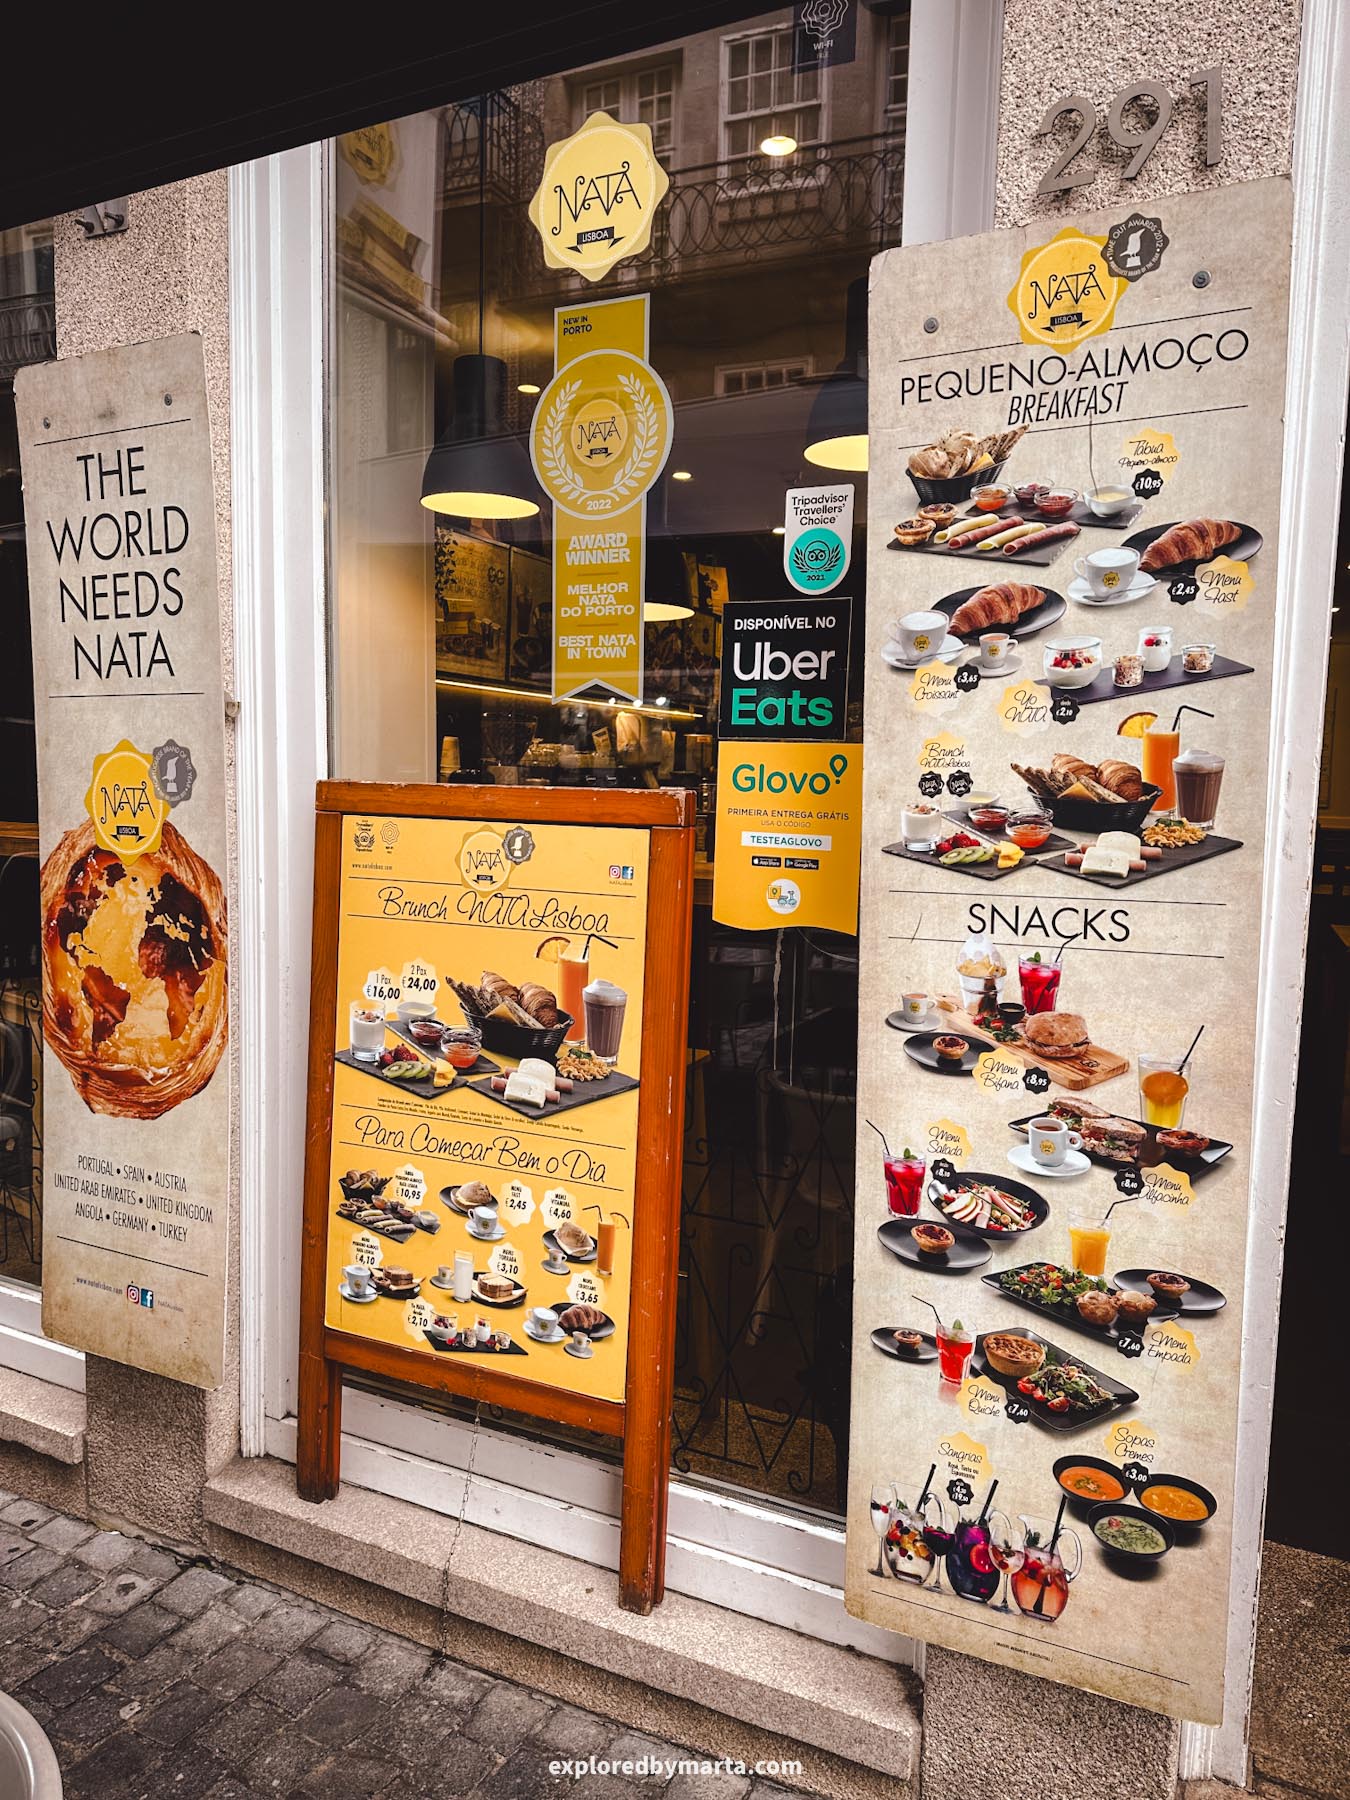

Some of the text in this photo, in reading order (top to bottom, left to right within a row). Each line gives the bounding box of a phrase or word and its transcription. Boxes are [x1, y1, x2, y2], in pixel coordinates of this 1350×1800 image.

[813, 40, 833, 50] WI-FI
[1037, 66, 1223, 195] 291
[552, 161, 642, 236] NATA
[582, 231, 608, 243] LISBOA
[1113, 224, 1127, 239] OUT
[1128, 218, 1157, 232] AWARDS
[1154, 229, 1164, 248] 2012
[1028, 264, 1106, 319] NATA
[563, 317, 579, 326] NEW
[1054, 315, 1078, 324] LISBOA
[563, 324, 592, 336] PORTO
[901, 329, 1249, 405] PEQUENO-ALMOÇO
[1007, 381, 1129, 426] BREAKFAST
[577, 416, 621, 449] NATA
[77, 446, 146, 501] THE
[1135, 476, 1161, 490] €10,95
[587, 500, 611, 511] 2022
[792, 493, 848, 507] Tripadvisor
[800, 515, 836, 526] Choice
[47, 505, 189, 565] WORLD
[568, 533, 627, 550] AWARD
[565, 548, 630, 565] WINNER
[1200, 570, 1242, 587] Menu
[59, 567, 184, 622] NEEDS
[568, 583, 628, 595] MELHOR
[1171, 583, 1195, 596] €2,45
[579, 594, 616, 605] NATA
[560, 605, 635, 617] DO PORTO
[734, 614, 836, 631] DISPONÍVEL NO
[559, 634, 636, 648] BEST NATA
[73, 629, 174, 680] NATA
[567, 647, 627, 659] IN TOWN
[733, 641, 835, 681] Uber
[920, 672, 952, 687] Menu
[957, 672, 978, 683] €3,65
[914, 687, 960, 701] Croissant
[731, 687, 833, 727] Eats
[1005, 706, 1048, 723] NATA
[164, 745, 179, 754] BRAND
[925, 743, 965, 757] Brunch
[732, 763, 831, 795] Glovo
[100, 781, 155, 824] NATA
[727, 808, 849, 821] PRIMEIRA ENTREGA GRÁTIS
[783, 820, 811, 828] CÓDIGO
[750, 835, 822, 847] TESTEAGLOVO
[466, 849, 505, 873] NATA
[378, 886, 447, 920] Brunch
[967, 903, 1130, 942] SNACKS
[411, 965, 427, 976] 2 Pax
[376, 974, 391, 985] 1 Pax
[983, 1058, 1018, 1075] Menu
[980, 1072, 1019, 1091] Bifana
[1026, 1074, 1047, 1086] €8,95
[929, 1127, 960, 1142] Menu
[355, 1115, 404, 1148] Para
[410, 1122, 493, 1163] Começar
[493, 1136, 540, 1172] Bem
[546, 1157, 559, 1174] o
[562, 1149, 606, 1183] Dia
[927, 1140, 962, 1156] Salada
[78, 1155, 187, 1192] PORTUGAL SPAIN AUSTRIA
[1145, 1174, 1182, 1191] Menu
[54, 1173, 213, 1223] UNITED ARAB EMIRATES UNITED KINGDOM
[1138, 1186, 1189, 1205] Alfacinha
[75, 1202, 188, 1242] ANGOLA GERMANY TURKEY
[1119, 1337, 1140, 1351] €7,60
[1151, 1331, 1187, 1350] Menu
[1147, 1344, 1191, 1364] Empada
[968, 1385, 1000, 1403] Menu
[969, 1398, 1000, 1416] Quiche
[1008, 1404, 1028, 1416] €7,60
[1114, 1427, 1155, 1448] Sopas
[938, 1442, 982, 1463] Sangrias
[1114, 1443, 1154, 1463] Cremes
